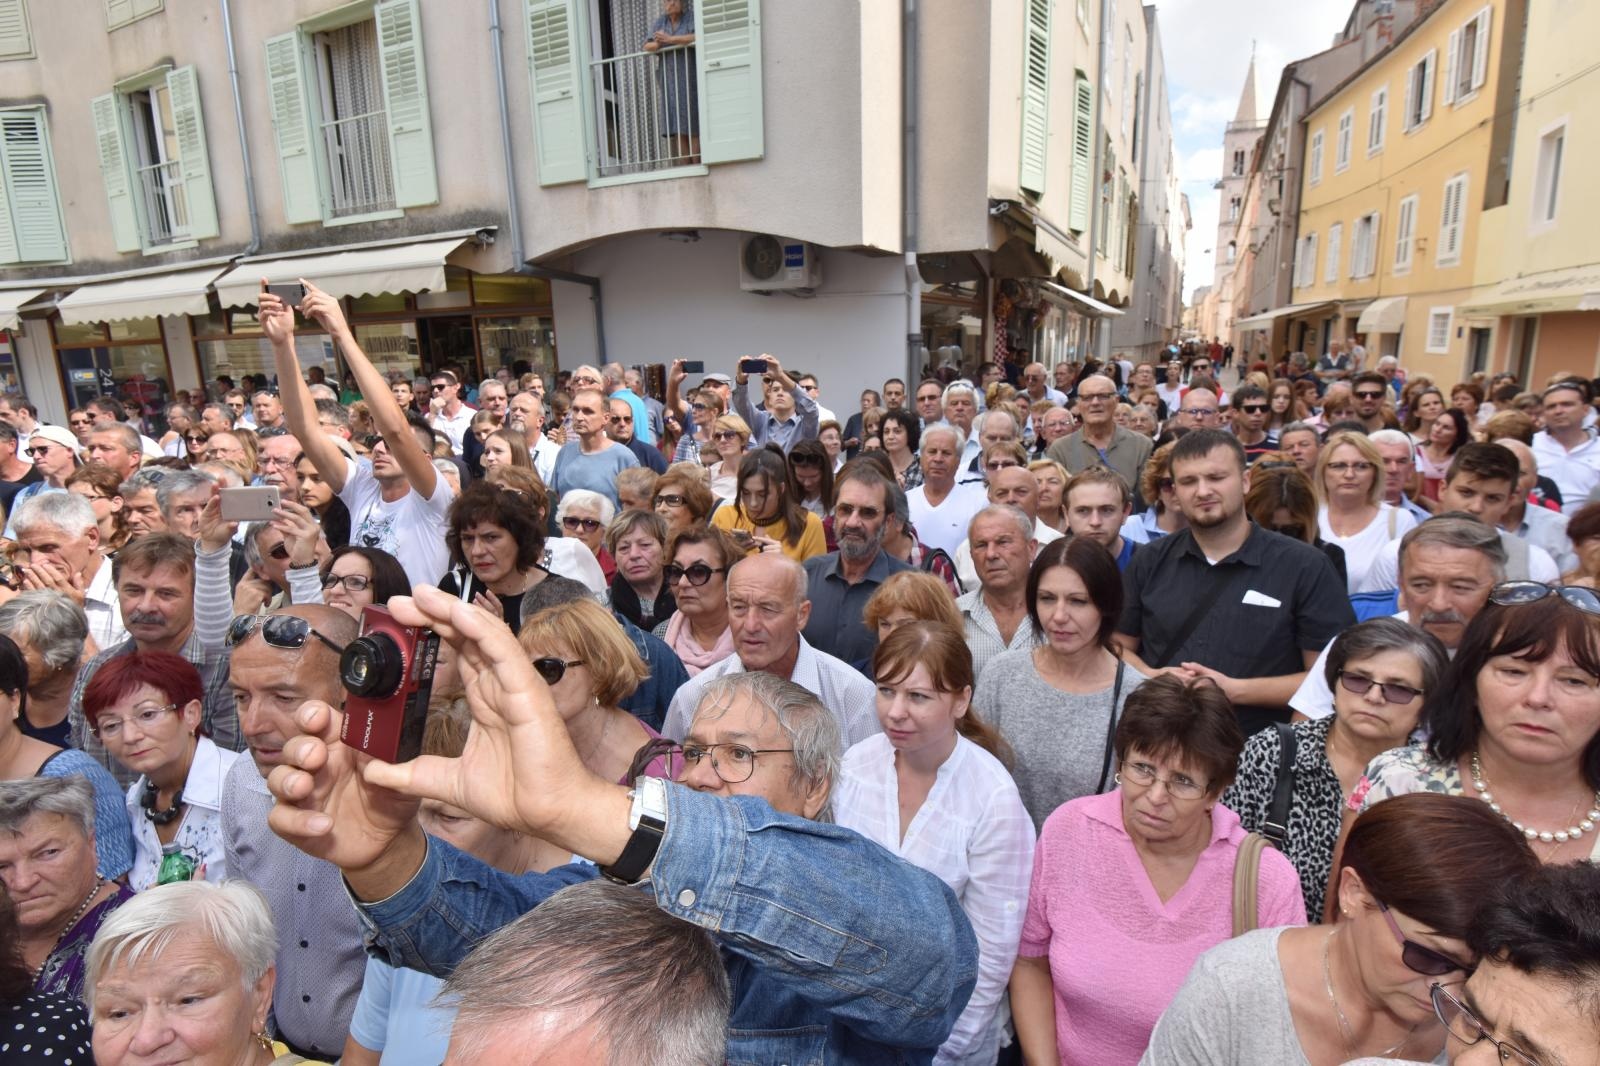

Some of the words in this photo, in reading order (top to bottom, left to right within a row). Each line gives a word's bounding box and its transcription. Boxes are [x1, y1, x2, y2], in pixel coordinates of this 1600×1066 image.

[99, 368, 115, 387] 24
[342, 712, 350, 740] Nikon
[363, 709, 374, 749] COOLPIX
